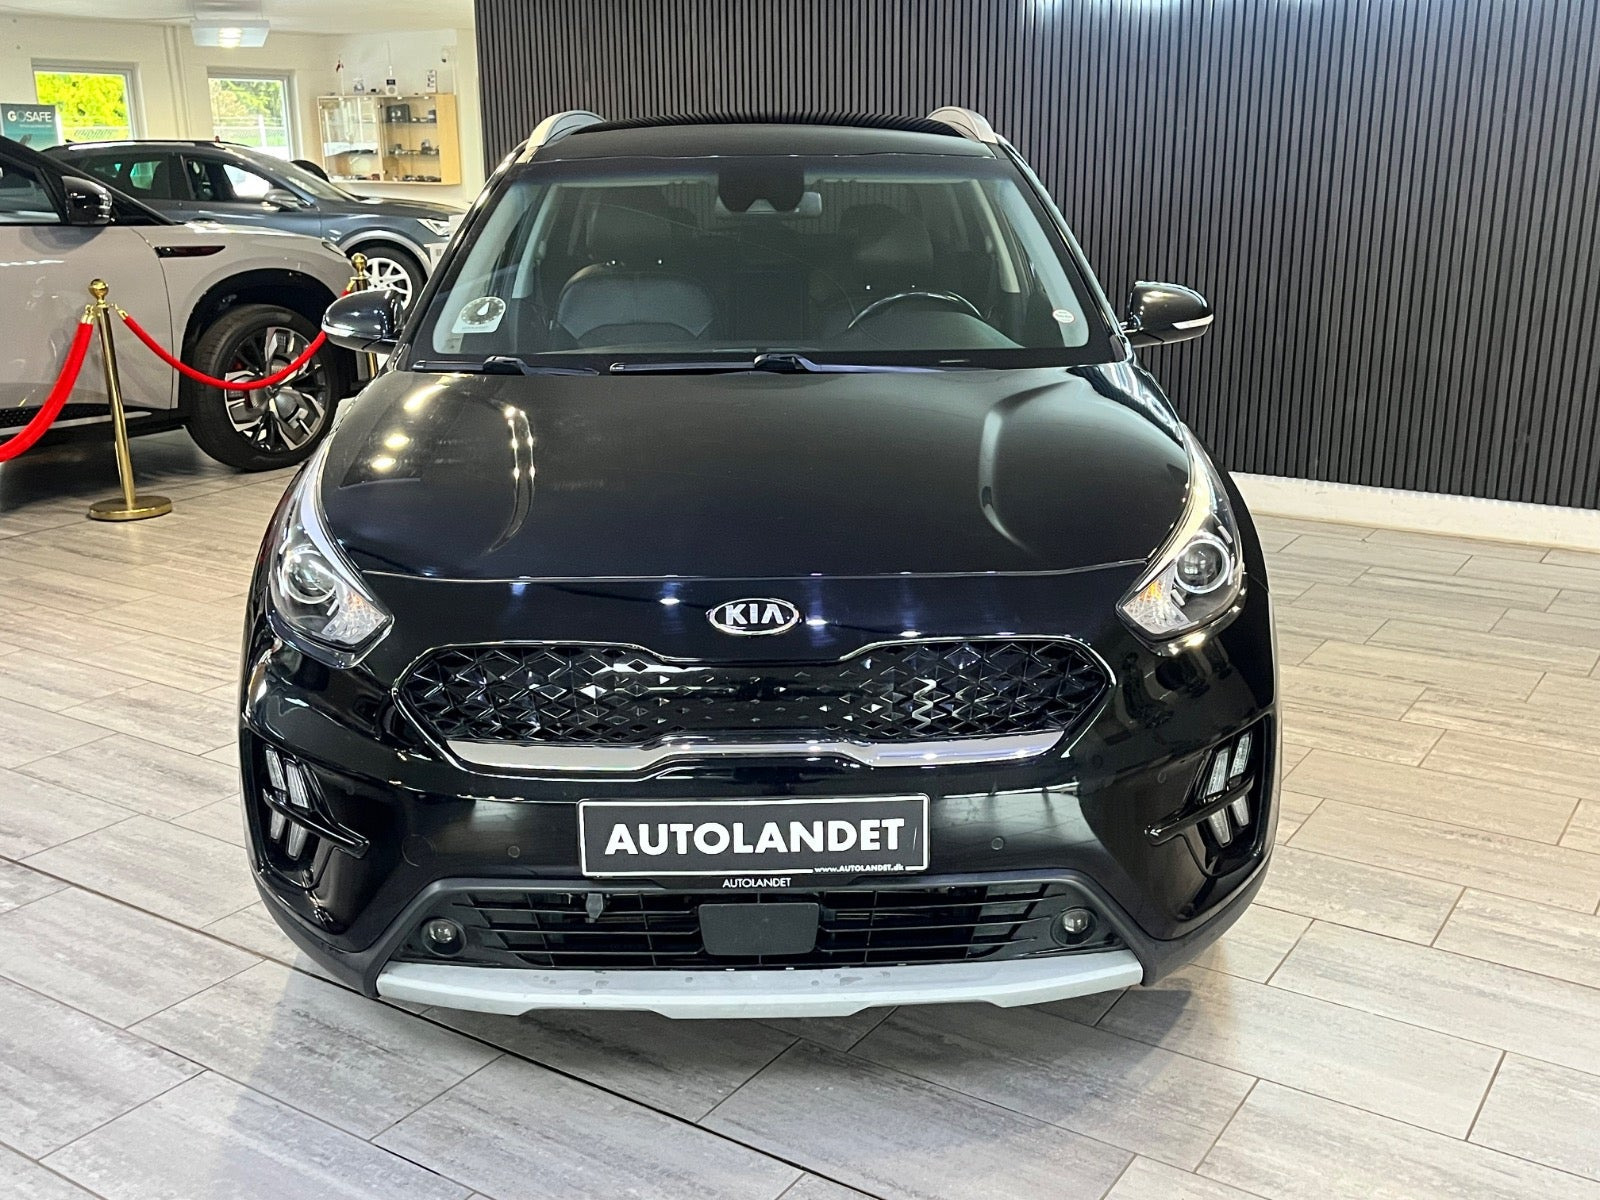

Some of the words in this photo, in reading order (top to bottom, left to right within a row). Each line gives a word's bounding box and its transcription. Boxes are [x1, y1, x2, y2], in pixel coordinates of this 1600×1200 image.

[725, 603, 785, 625] KIA
[604, 818, 905, 855] AUTOLANDET
[814, 863, 904, 873] www.AUTOLANDET.dk
[722, 877, 792, 888] AUTOLANDET
